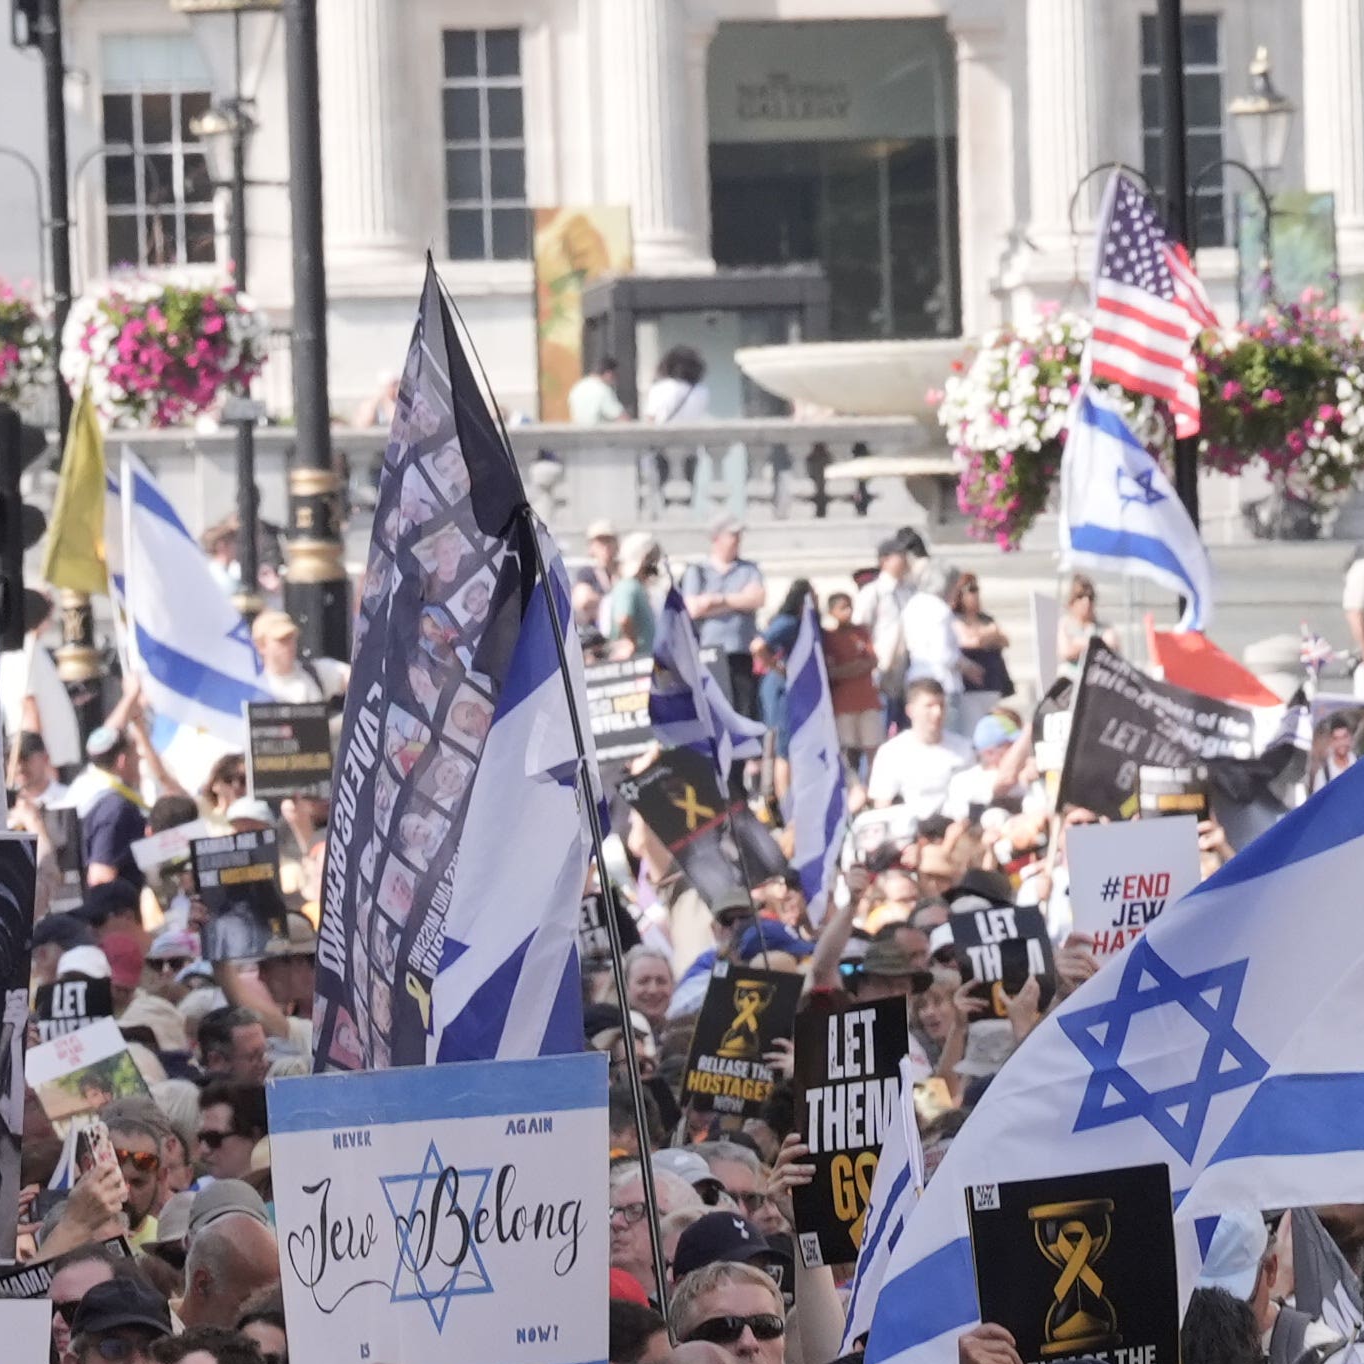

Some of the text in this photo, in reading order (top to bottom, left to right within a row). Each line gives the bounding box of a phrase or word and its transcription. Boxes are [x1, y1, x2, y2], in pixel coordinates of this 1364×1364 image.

[1101, 872, 1171, 902] #END
[974, 907, 1019, 944] LET
[1112, 899, 1166, 928] JEW
[52, 980, 87, 1018] LET
[827, 1008, 876, 1080] LET
[697, 1054, 749, 1080] RELEASE
[332, 1130, 373, 1150] NEVER
[504, 1117, 554, 1137] AGAIN
[287, 1164, 587, 1315] Jew Belong
[516, 1325, 560, 1345] NOW!
